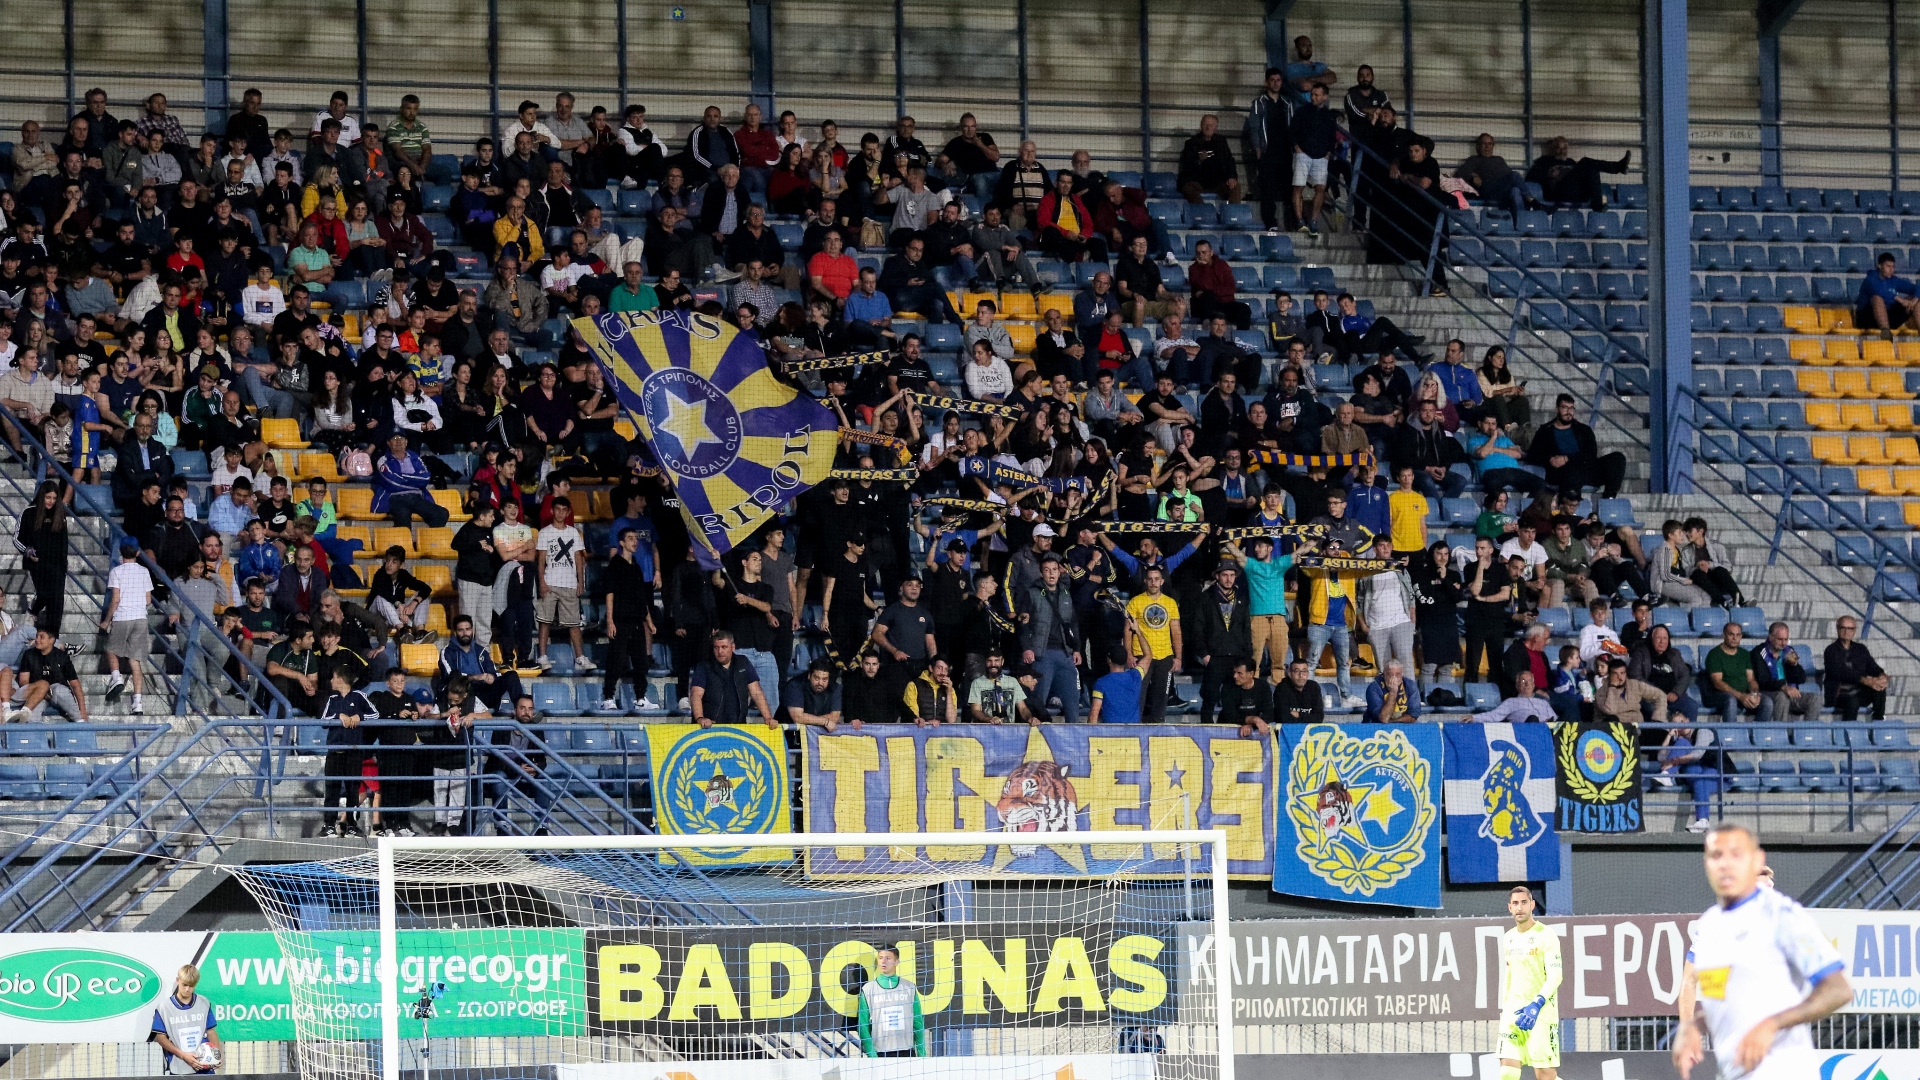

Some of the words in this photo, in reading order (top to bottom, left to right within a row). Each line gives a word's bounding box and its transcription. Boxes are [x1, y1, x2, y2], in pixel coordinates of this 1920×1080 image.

[796, 351, 883, 371] TIGERS
[656, 372, 720, 402] ΤΡΙΠΟΛΗΣ
[915, 393, 1012, 417] TIGERS
[664, 452, 731, 476] FOOTBALL
[725, 416, 738, 451] CLUB
[830, 469, 894, 480] STERAS
[995, 467, 1039, 484] ASTERAS
[1101, 521, 1210, 533] TIGERS
[1225, 524, 1325, 540] TIGERS
[1322, 557, 1386, 570] ASTERAS
[696, 747, 734, 764] Tigers
[818, 734, 1266, 862] TIGERS
[1558, 796, 1640, 832] TIGERS
[1852, 924, 1920, 978] ΑΠ
[88, 976, 142, 996] eco
[873, 994, 893, 1004] BALL
[892, 993, 909, 1002] BOY
[1375, 993, 1451, 1016] ΤΑΒΕΡΝΑ
[1851, 988, 1920, 1009] ΜΕΤΑΦ
[457, 1000, 568, 1018] ΖΩΟΤΡΟΦΕΣ
[169, 1015, 191, 1025] BALL
